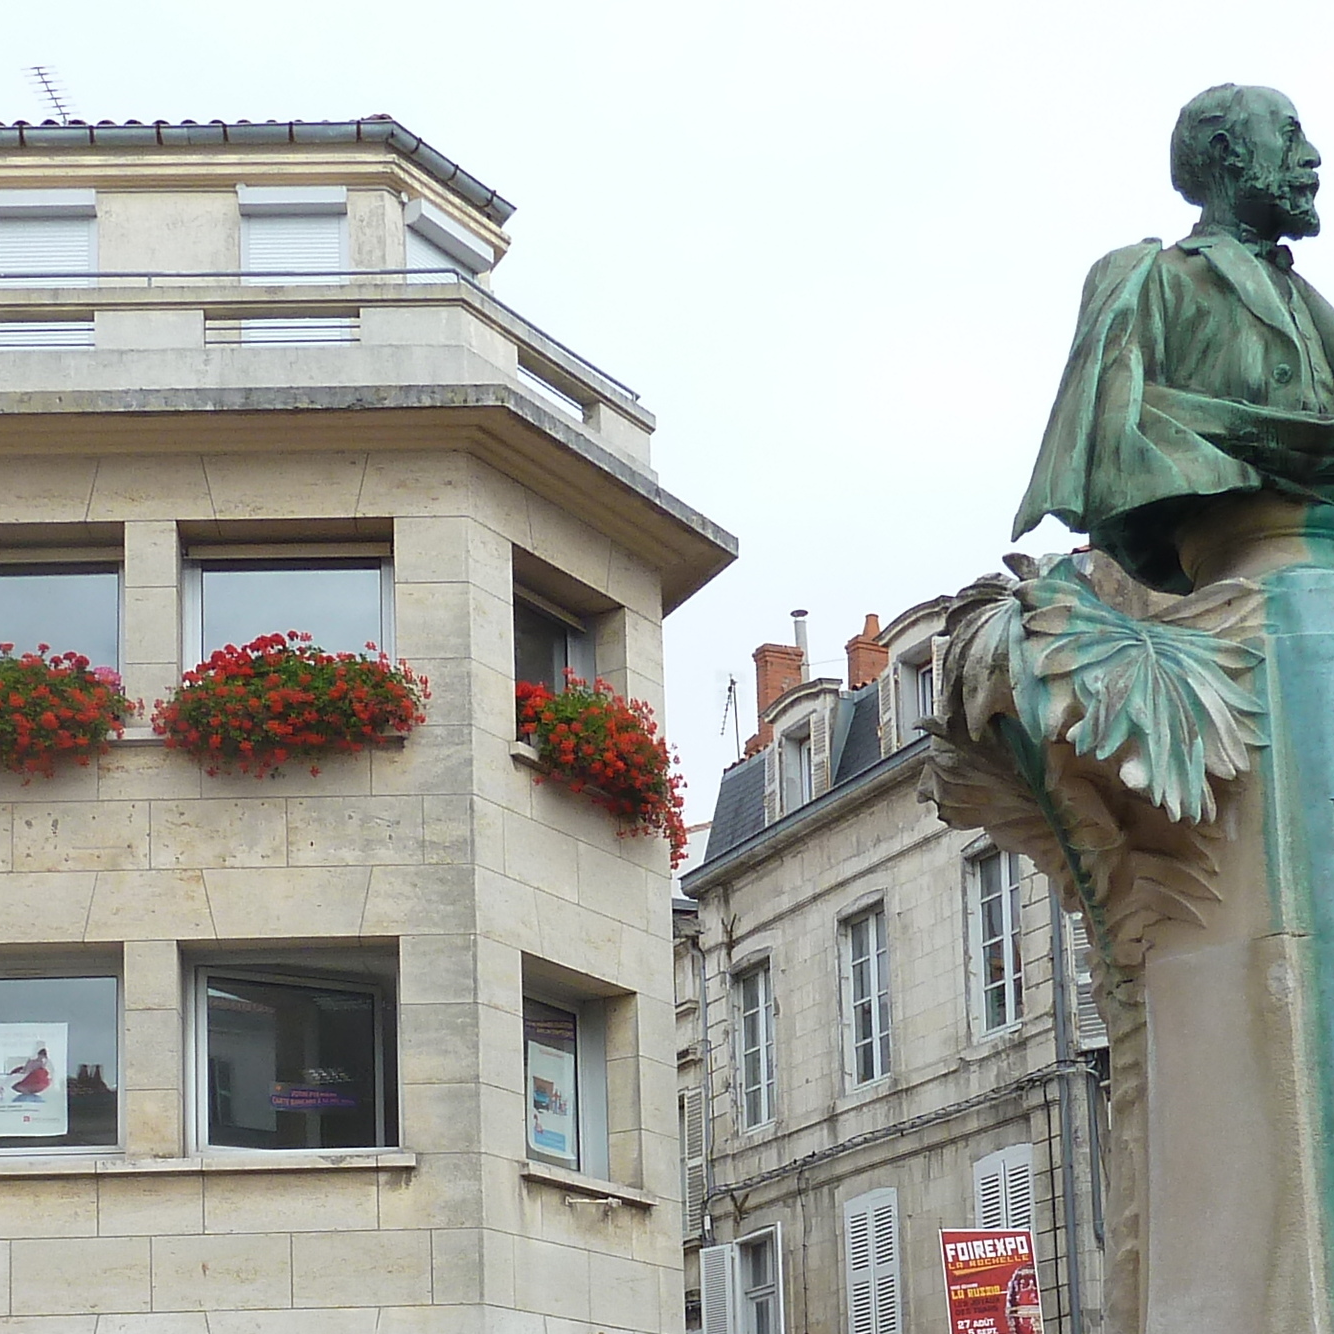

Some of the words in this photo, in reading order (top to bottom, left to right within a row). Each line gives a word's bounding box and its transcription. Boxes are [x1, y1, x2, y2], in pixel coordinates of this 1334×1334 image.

[945, 1236, 1029, 1262] FOIREXPO
[948, 1260, 964, 1270] LA
[969, 1255, 1030, 1267] ROCHELLE
[957, 1320, 970, 1330] 27
